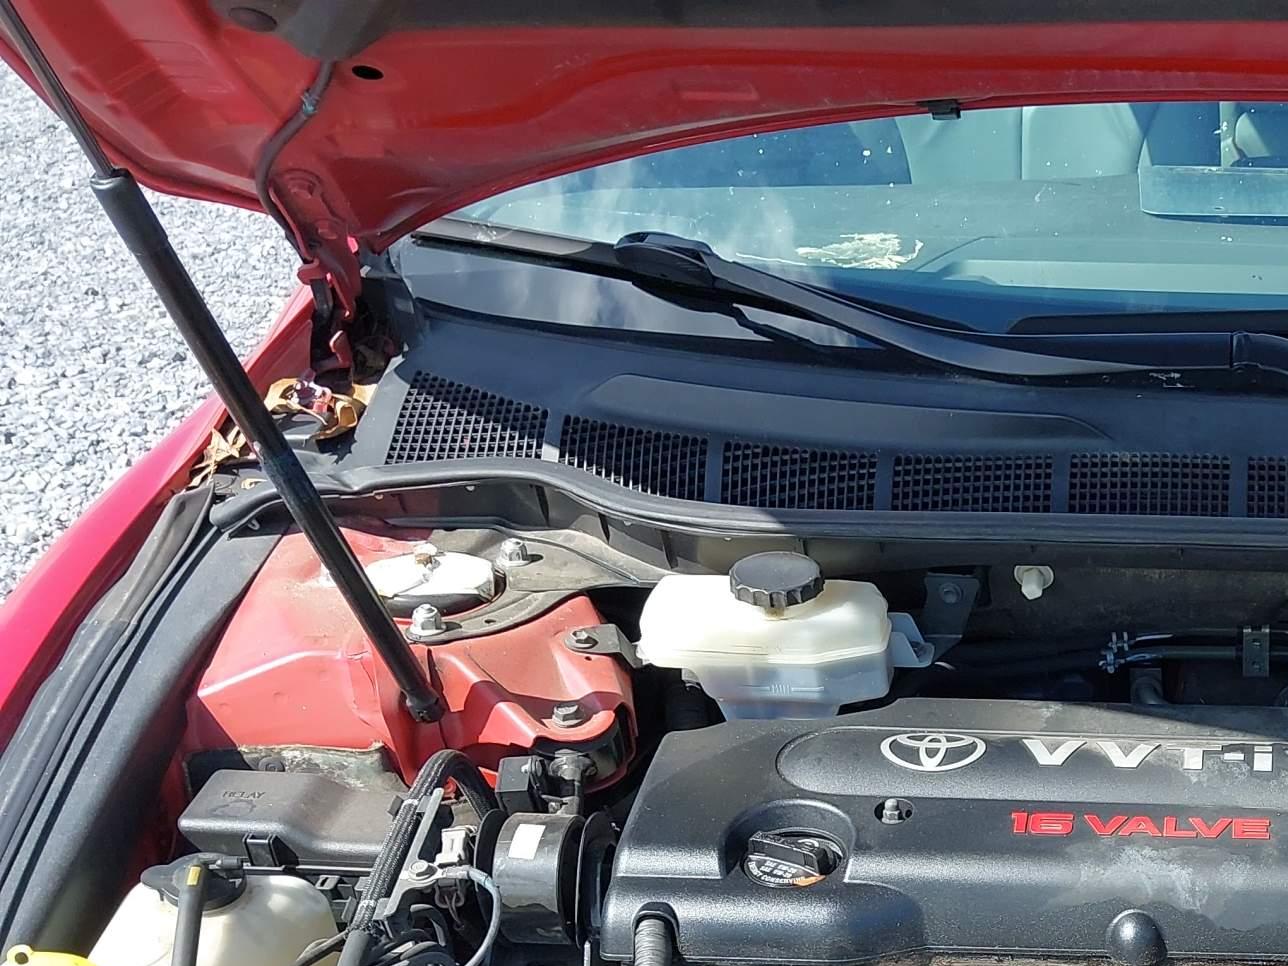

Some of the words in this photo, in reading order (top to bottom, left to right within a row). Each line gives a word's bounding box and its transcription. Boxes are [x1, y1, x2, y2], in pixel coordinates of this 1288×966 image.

[222, 791, 266, 799] RELAY
[1011, 811, 1075, 836] 16
[1084, 813, 1271, 840] VALVE
